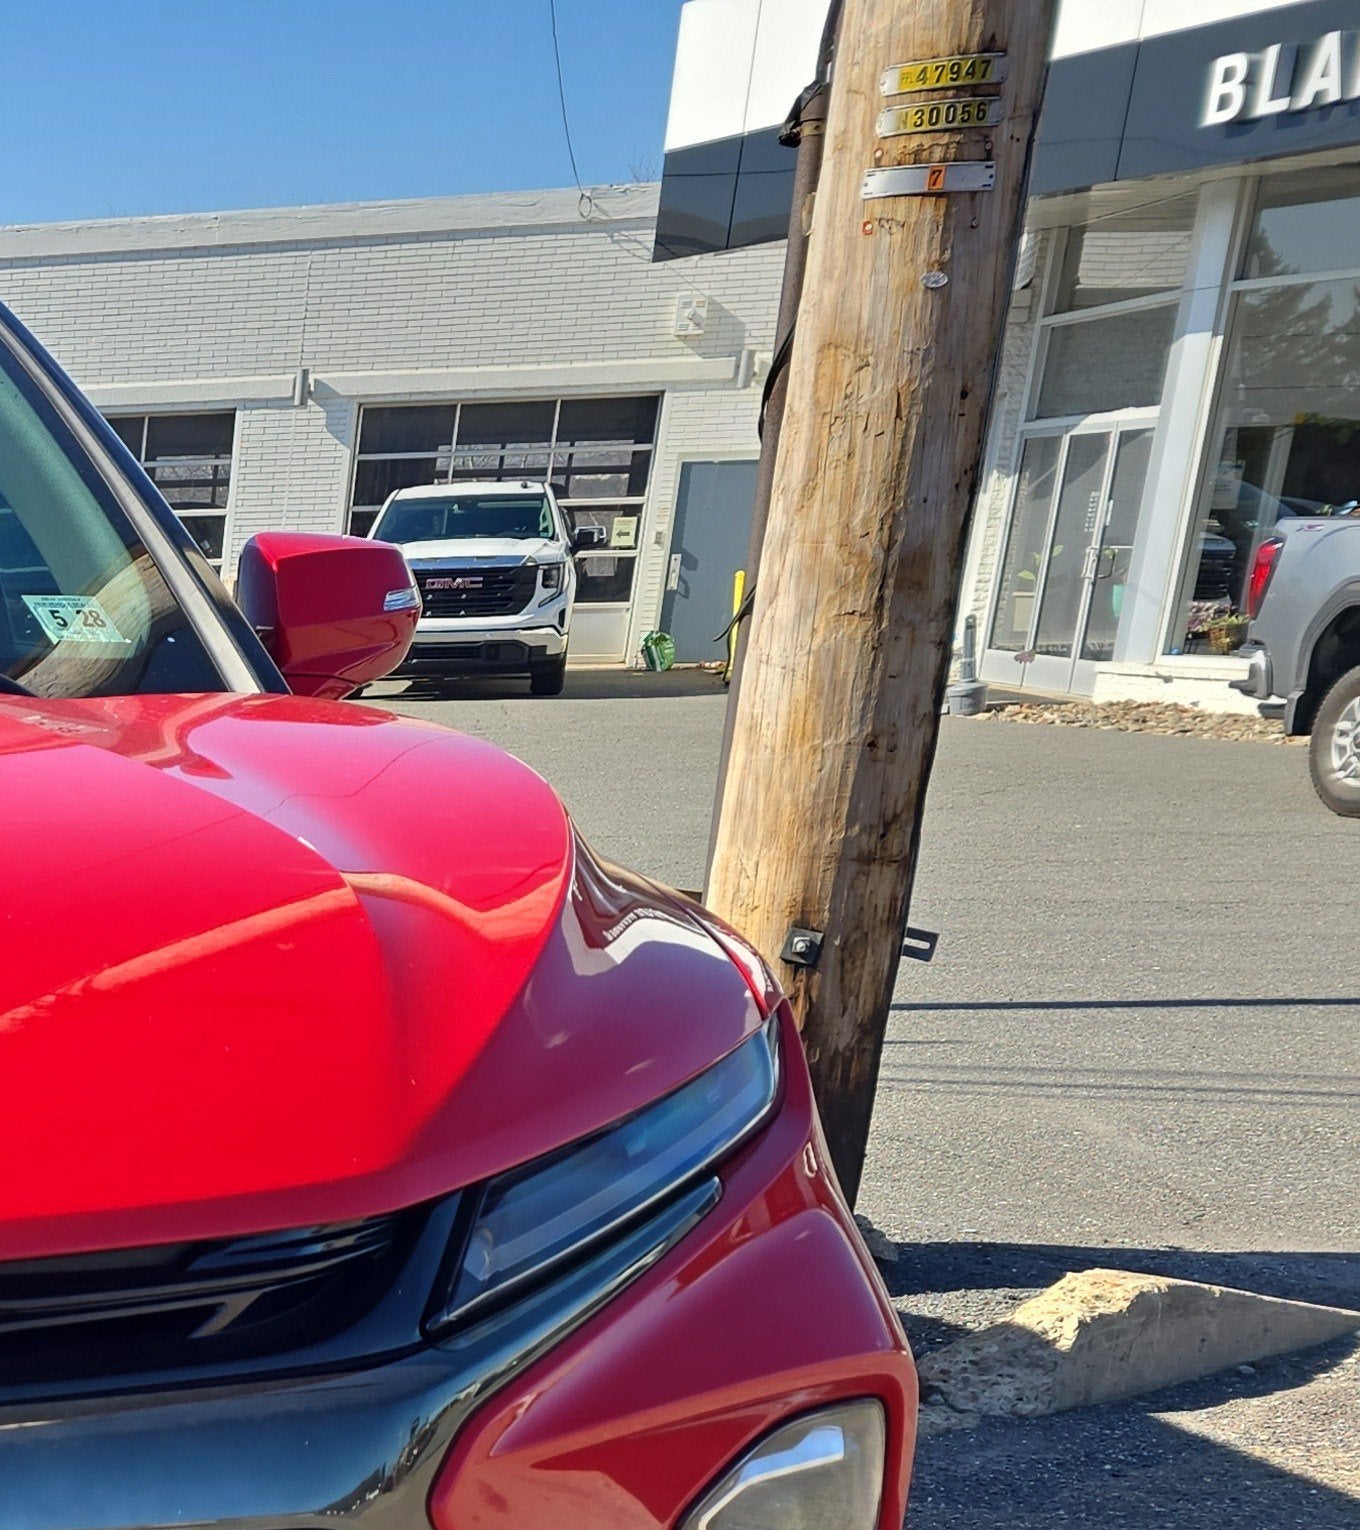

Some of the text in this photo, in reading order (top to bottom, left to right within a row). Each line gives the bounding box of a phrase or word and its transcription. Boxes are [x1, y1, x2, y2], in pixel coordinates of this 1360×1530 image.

[917, 59, 992, 85] 47947
[1199, 30, 1360, 128] BLA
[931, 169, 943, 187] 7
[425, 576, 484, 590] GMC
[48, 609, 107, 629] 5 28
